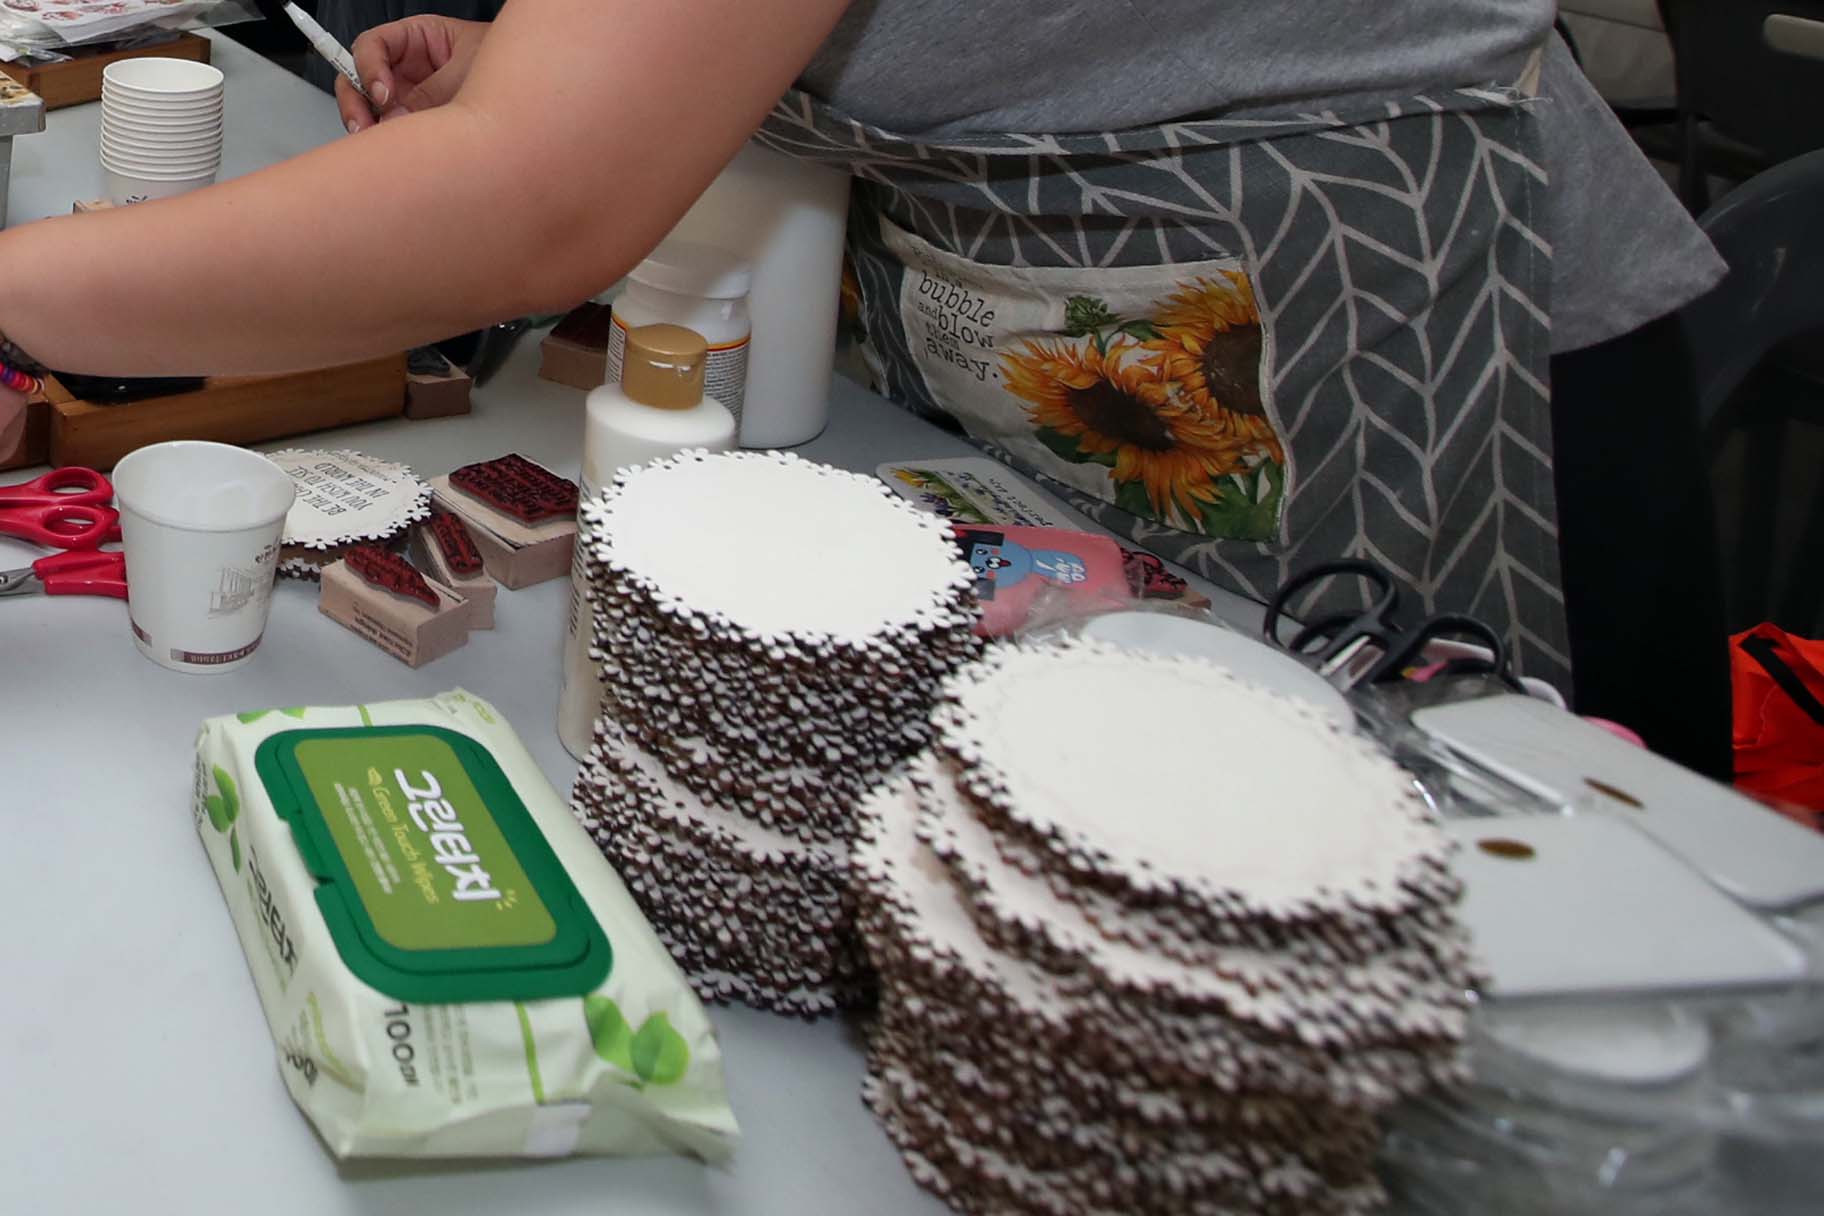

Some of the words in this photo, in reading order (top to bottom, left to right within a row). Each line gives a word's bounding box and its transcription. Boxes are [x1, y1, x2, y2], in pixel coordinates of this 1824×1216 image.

[917, 302, 938, 320] and
[938, 305, 994, 348] blow
[918, 271, 996, 327] bubble
[926, 337, 999, 382] away.
[373, 786, 398, 823] Green
[392, 823, 422, 861] Touch
[411, 861, 440, 904] Wipes
[394, 769, 502, 901] 그린터치
